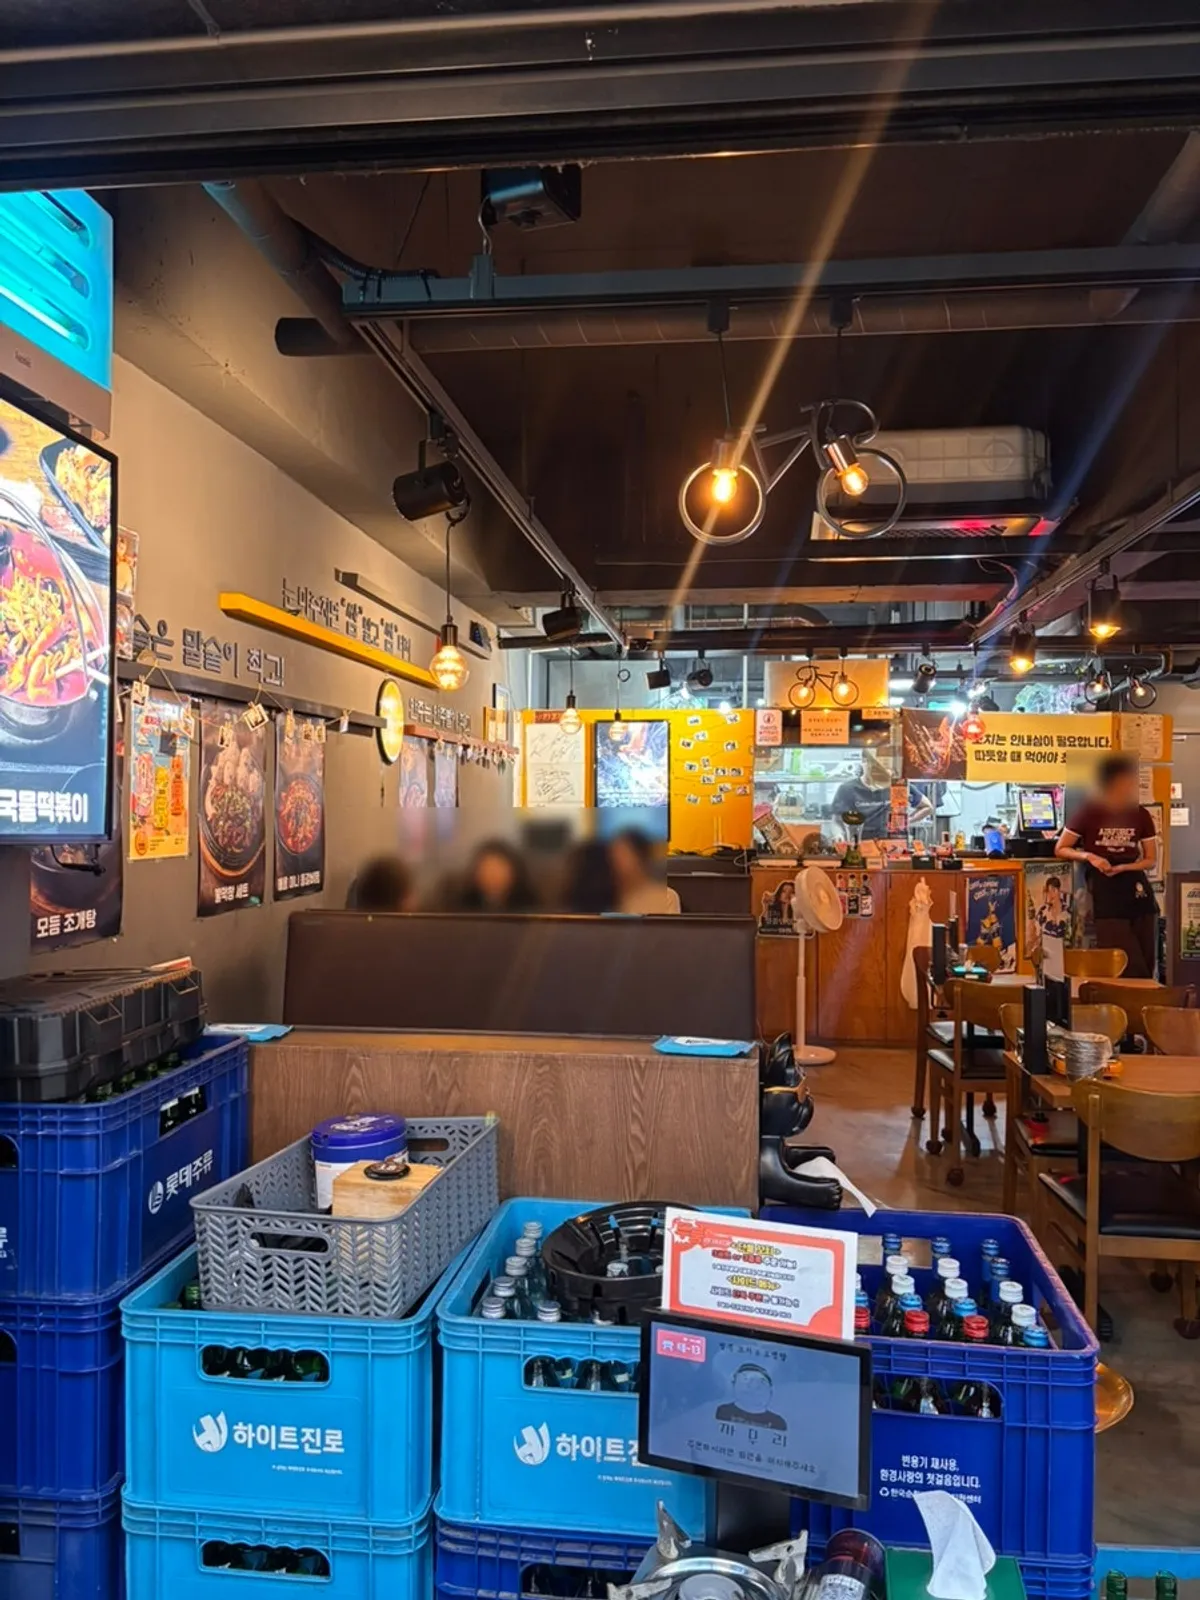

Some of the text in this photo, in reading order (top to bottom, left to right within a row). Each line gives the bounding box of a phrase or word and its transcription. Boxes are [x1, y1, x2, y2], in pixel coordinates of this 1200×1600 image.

[247, 647, 284, 687] 최고
[1024, 750, 1058, 764] 먹어야
[1056, 735, 1112, 748] 필요합니다.
[36, 908, 97, 938] 모듬 조개탕
[166, 1149, 213, 1201] 롯데주류
[232, 1421, 345, 1455] 하이트진로
[555, 1433, 645, 1467] 하이트진
[880, 1469, 981, 1488] 환경사랑의 첫걸음입니다.
